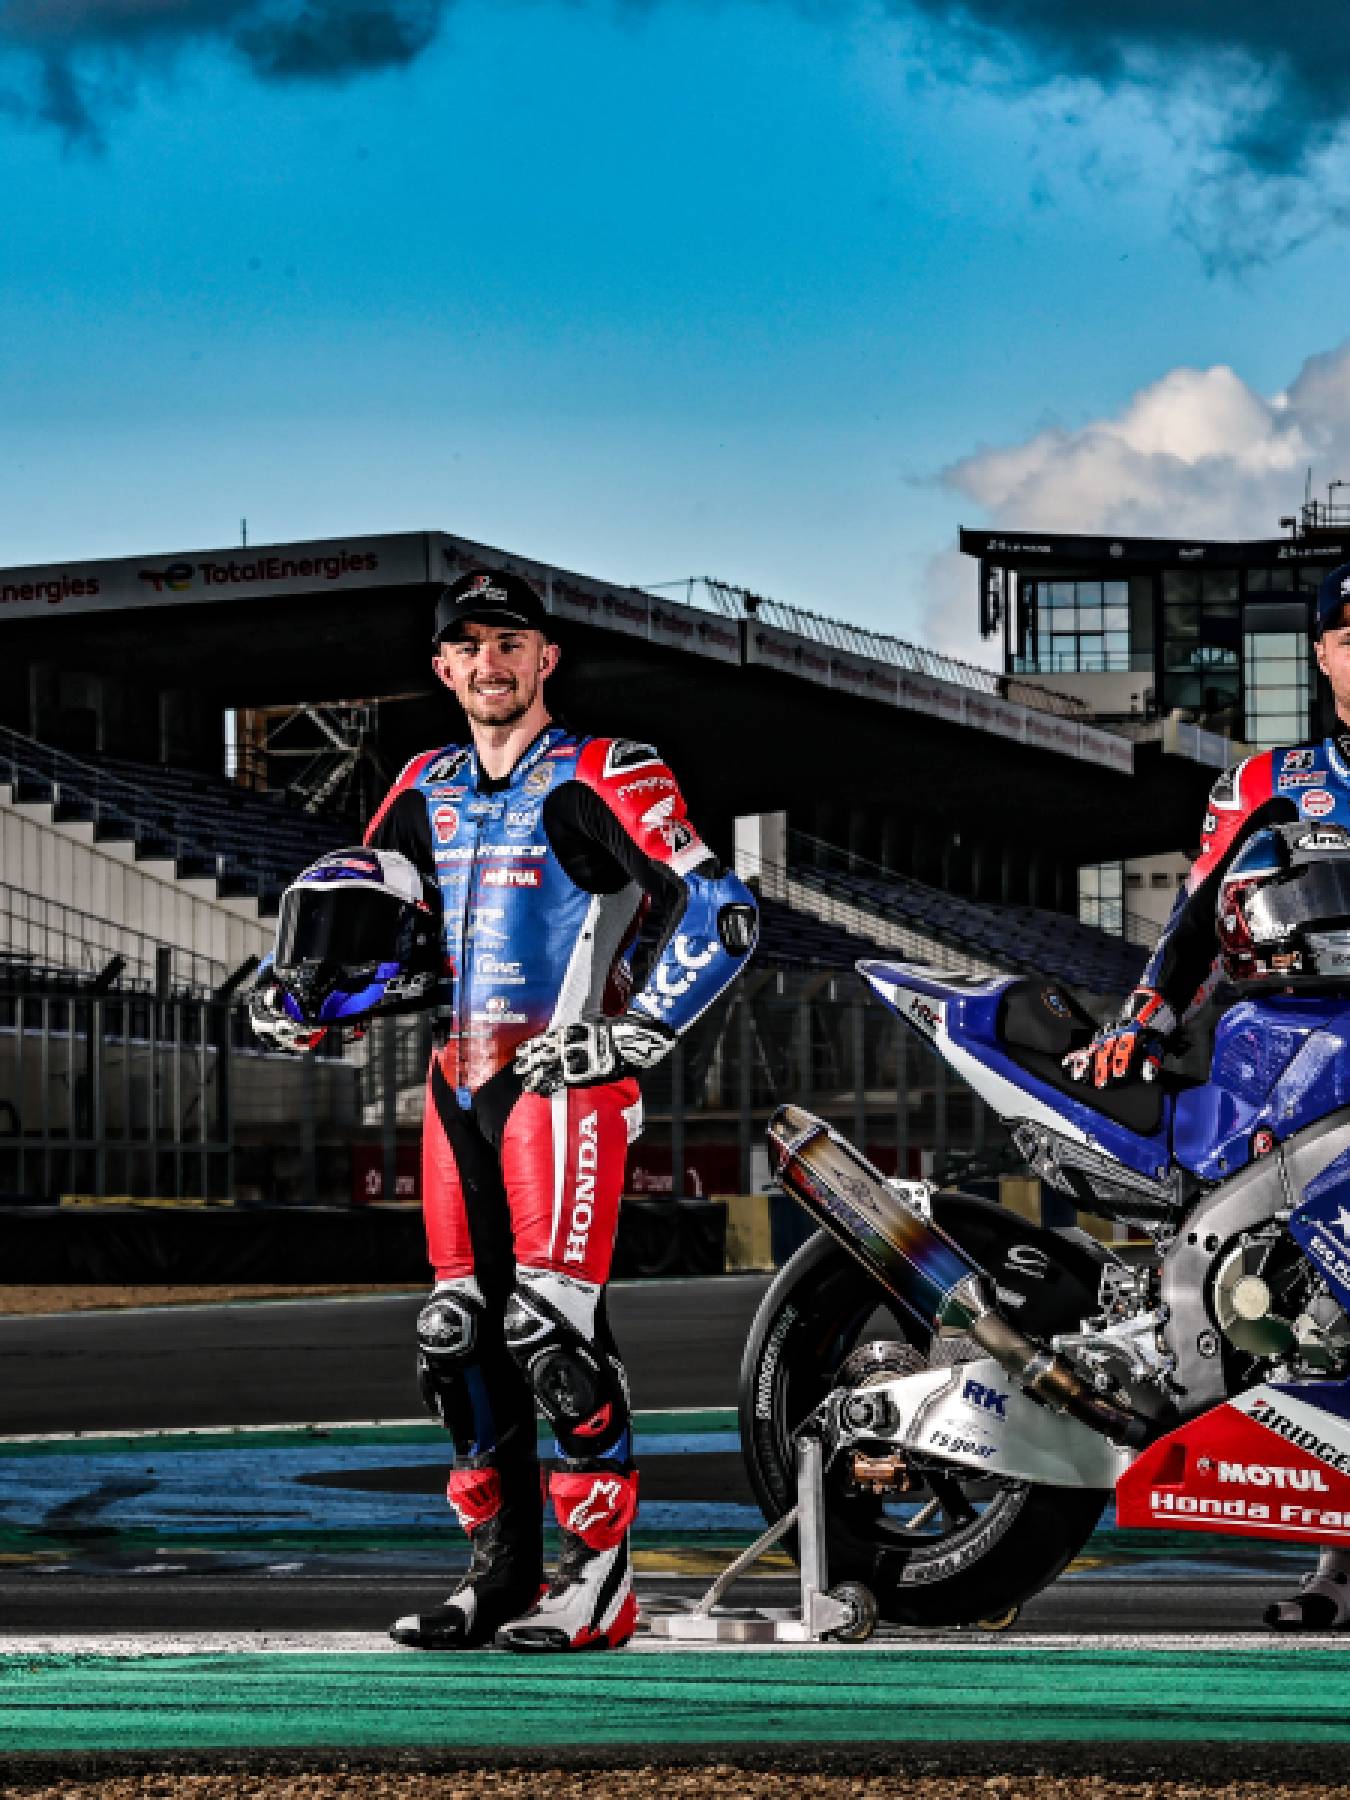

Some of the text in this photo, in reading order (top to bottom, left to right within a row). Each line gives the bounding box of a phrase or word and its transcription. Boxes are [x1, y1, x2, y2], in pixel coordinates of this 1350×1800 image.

[199, 551, 378, 583] TotalEnergies
[0, 574, 100, 604] nergies
[563, 1110, 598, 1264] HONDA
[962, 1379, 1009, 1416] RK
[1217, 1460, 1329, 1492] MOTUL
[1150, 1490, 1270, 1520] Honda
